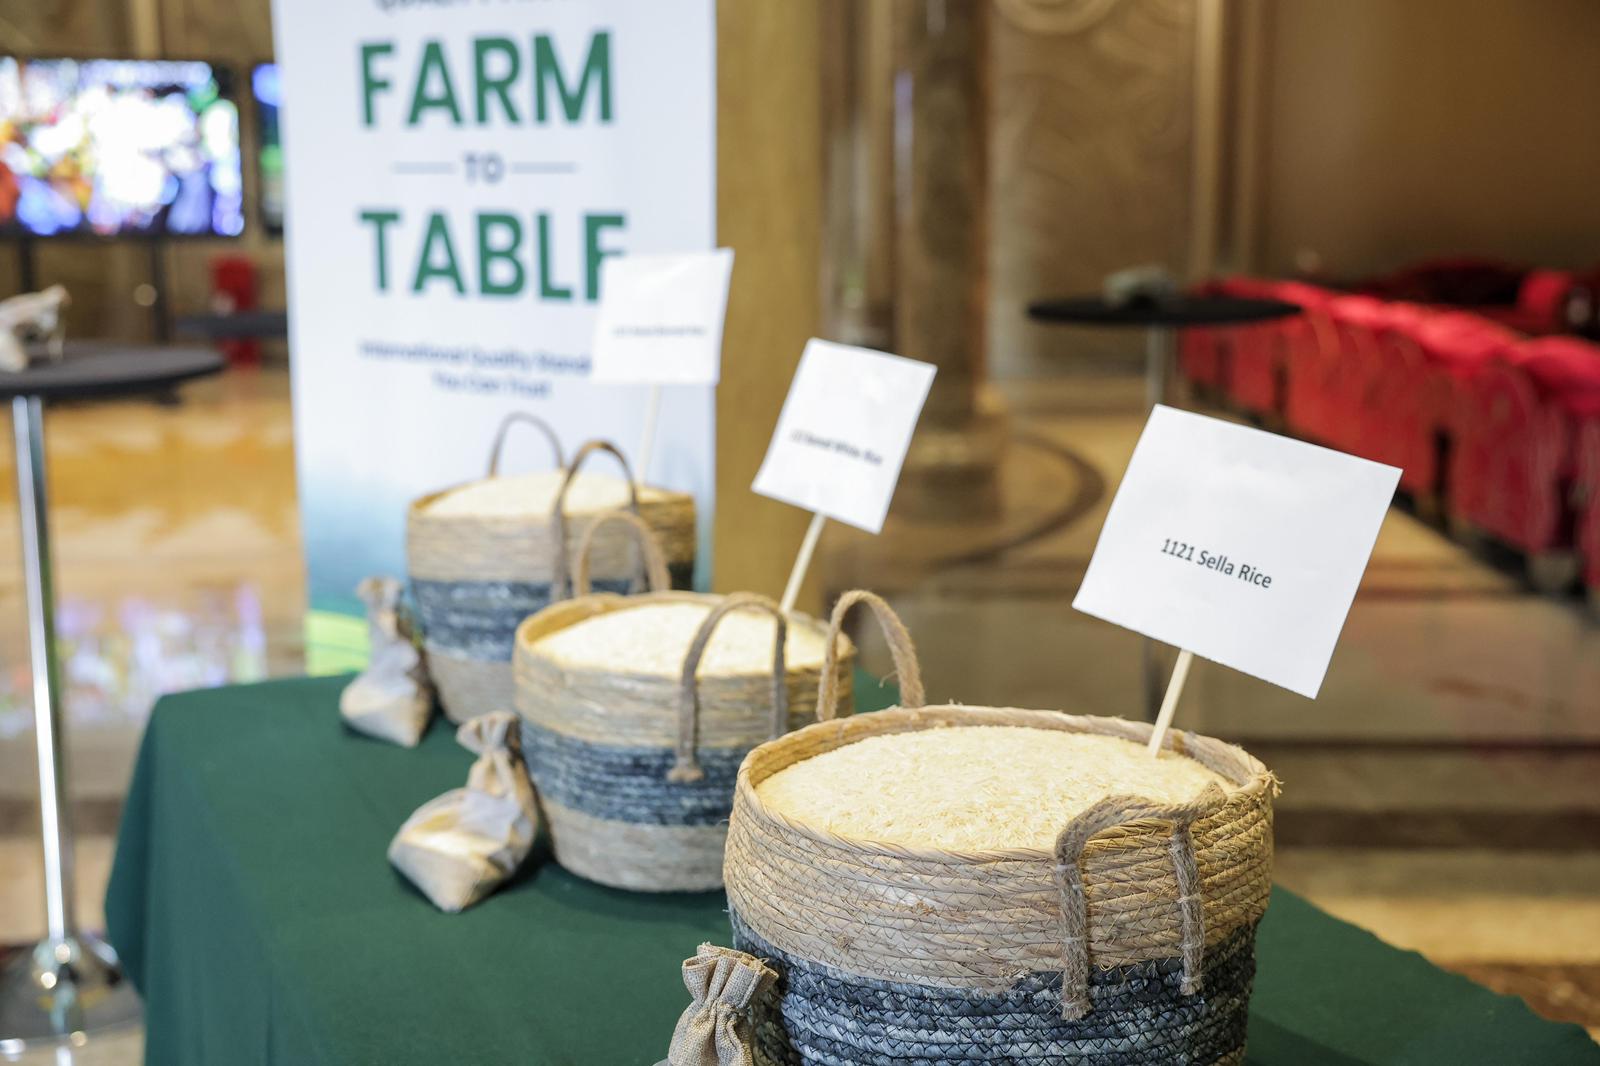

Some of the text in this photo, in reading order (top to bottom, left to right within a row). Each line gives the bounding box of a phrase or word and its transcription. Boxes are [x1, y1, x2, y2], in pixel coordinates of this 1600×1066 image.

[359, 30, 613, 127] FARM
[462, 152, 505, 183] TO
[1161, 538, 1272, 589] 1121 Sella Rice
